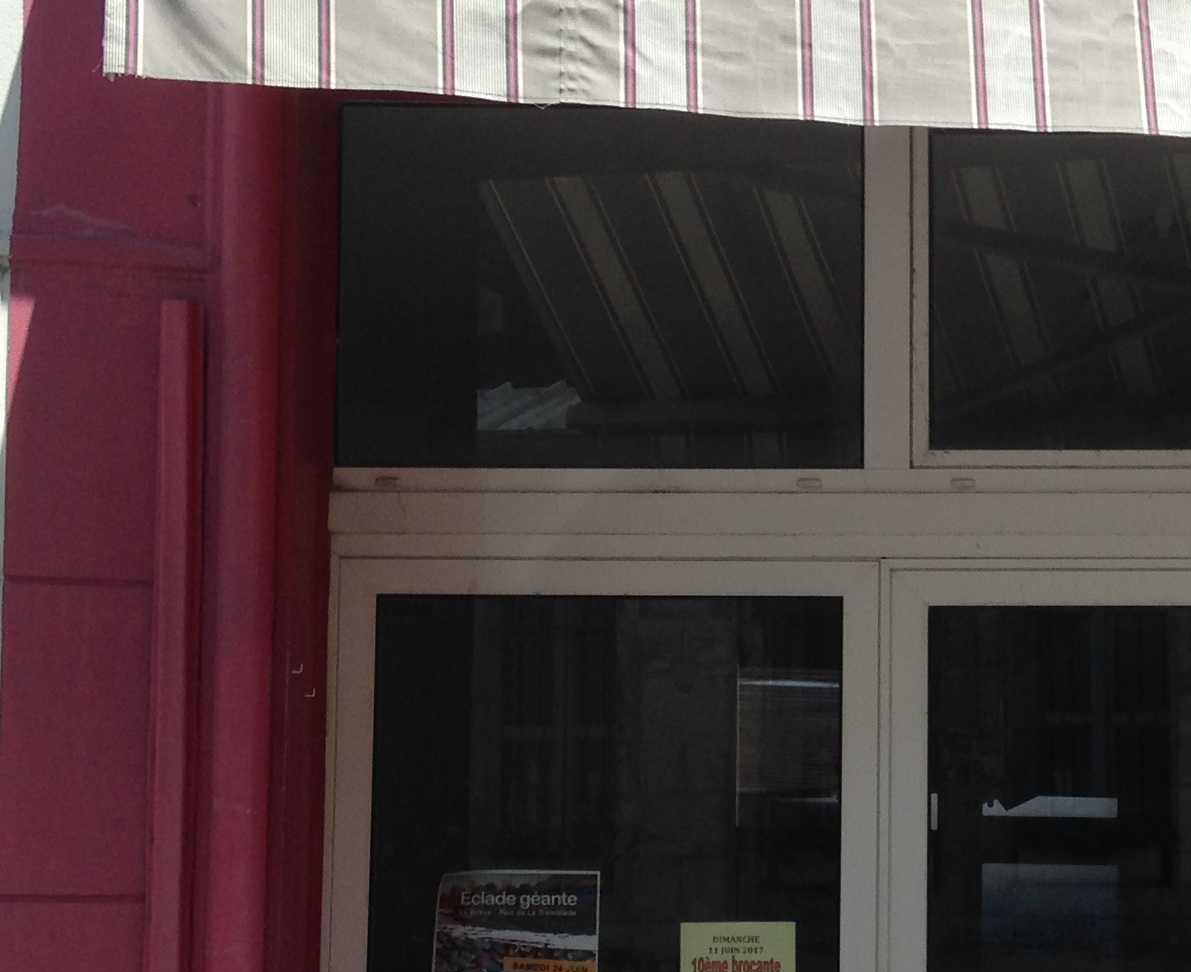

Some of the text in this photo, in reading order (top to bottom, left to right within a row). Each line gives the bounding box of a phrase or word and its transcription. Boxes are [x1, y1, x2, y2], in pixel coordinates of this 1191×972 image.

[519, 890, 578, 909] géante
[712, 935, 760, 944] DIMANCHE
[720, 947, 740, 955] JUIN
[742, 946, 764, 954] 2017
[512, 961, 550, 972] SAMEDI
[552, 964, 563, 972] 24
